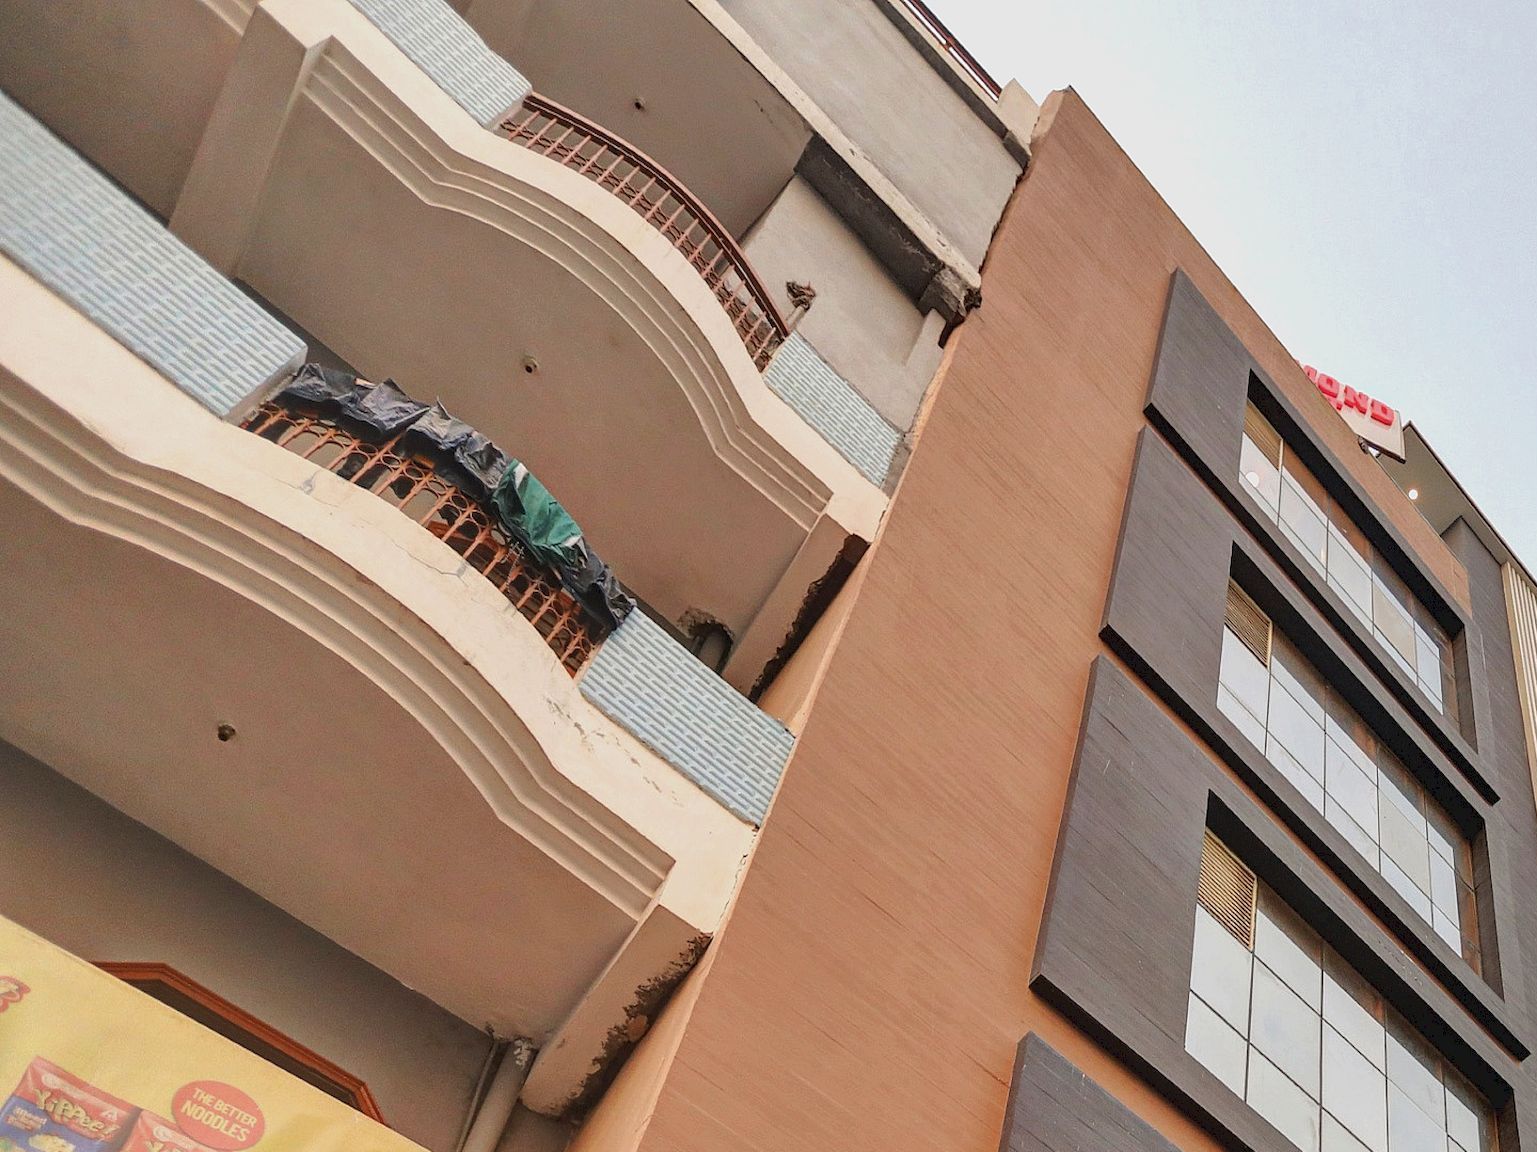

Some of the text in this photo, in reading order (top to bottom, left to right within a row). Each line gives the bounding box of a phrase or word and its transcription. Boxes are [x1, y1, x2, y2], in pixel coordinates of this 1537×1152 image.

[181, 1100, 251, 1142] NOODLES
[192, 1087, 258, 1129] THE BETTER
